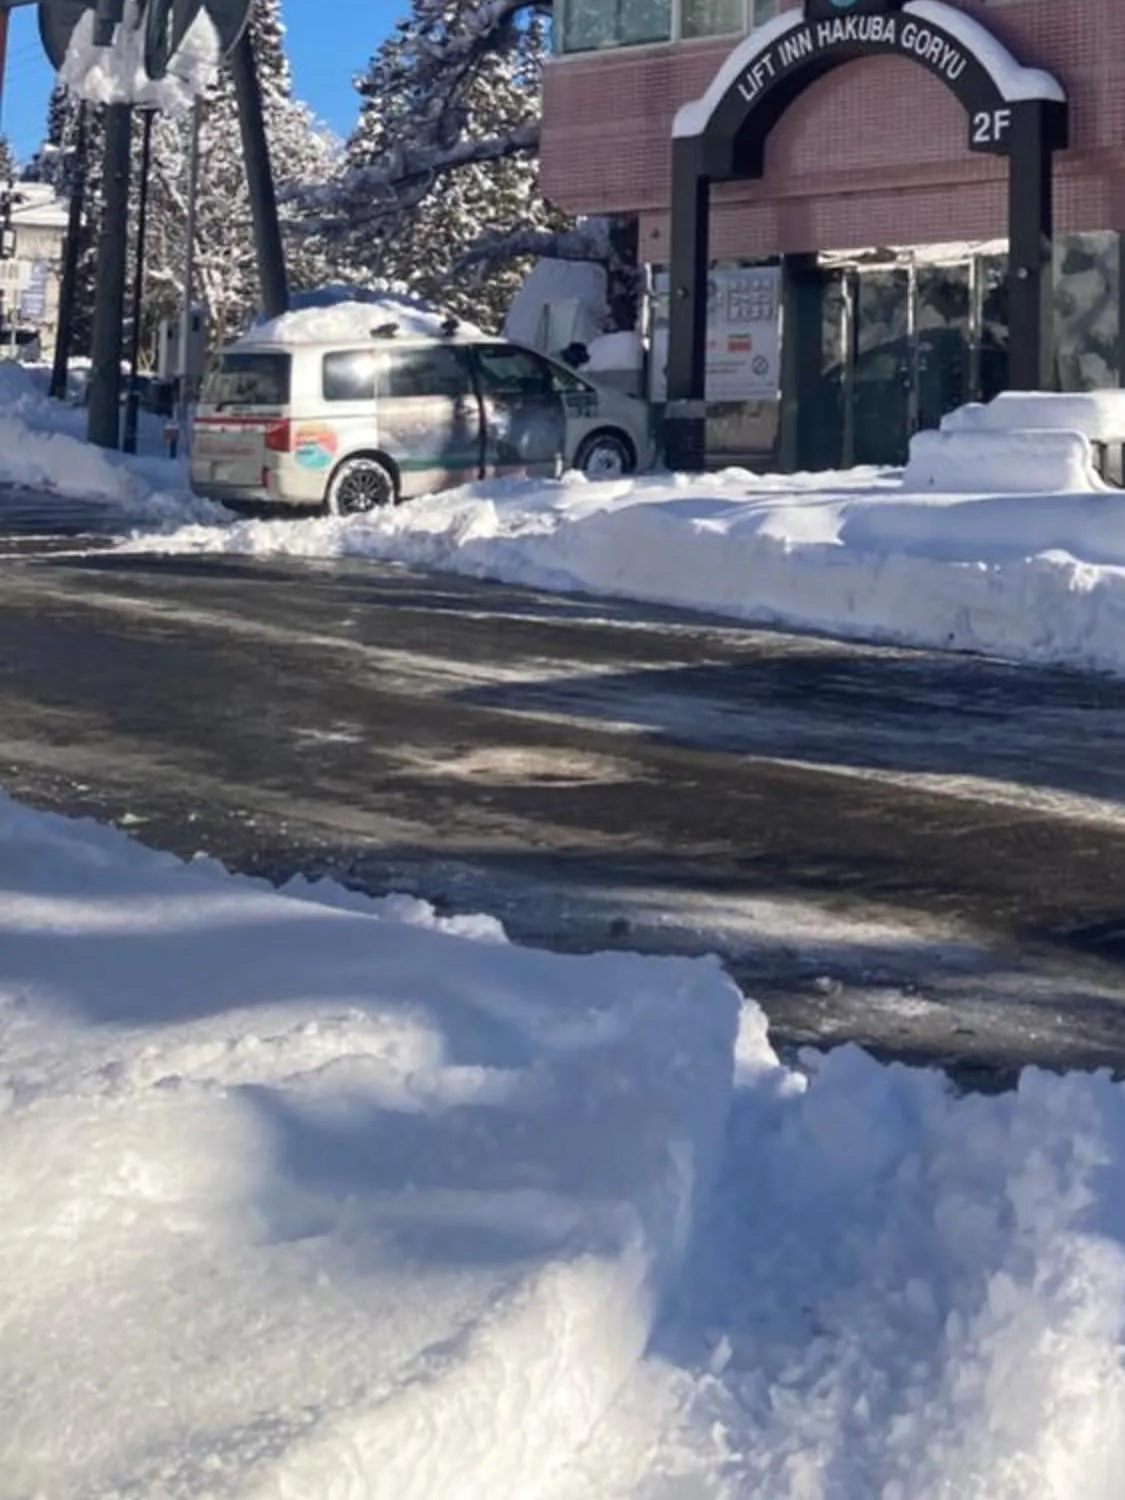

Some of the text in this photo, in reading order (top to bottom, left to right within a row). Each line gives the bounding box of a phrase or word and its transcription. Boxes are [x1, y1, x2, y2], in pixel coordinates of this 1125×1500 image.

[738, 15, 967, 101] LIFT INN HAKUBA GORYU
[973, 110, 1011, 143] 2F
